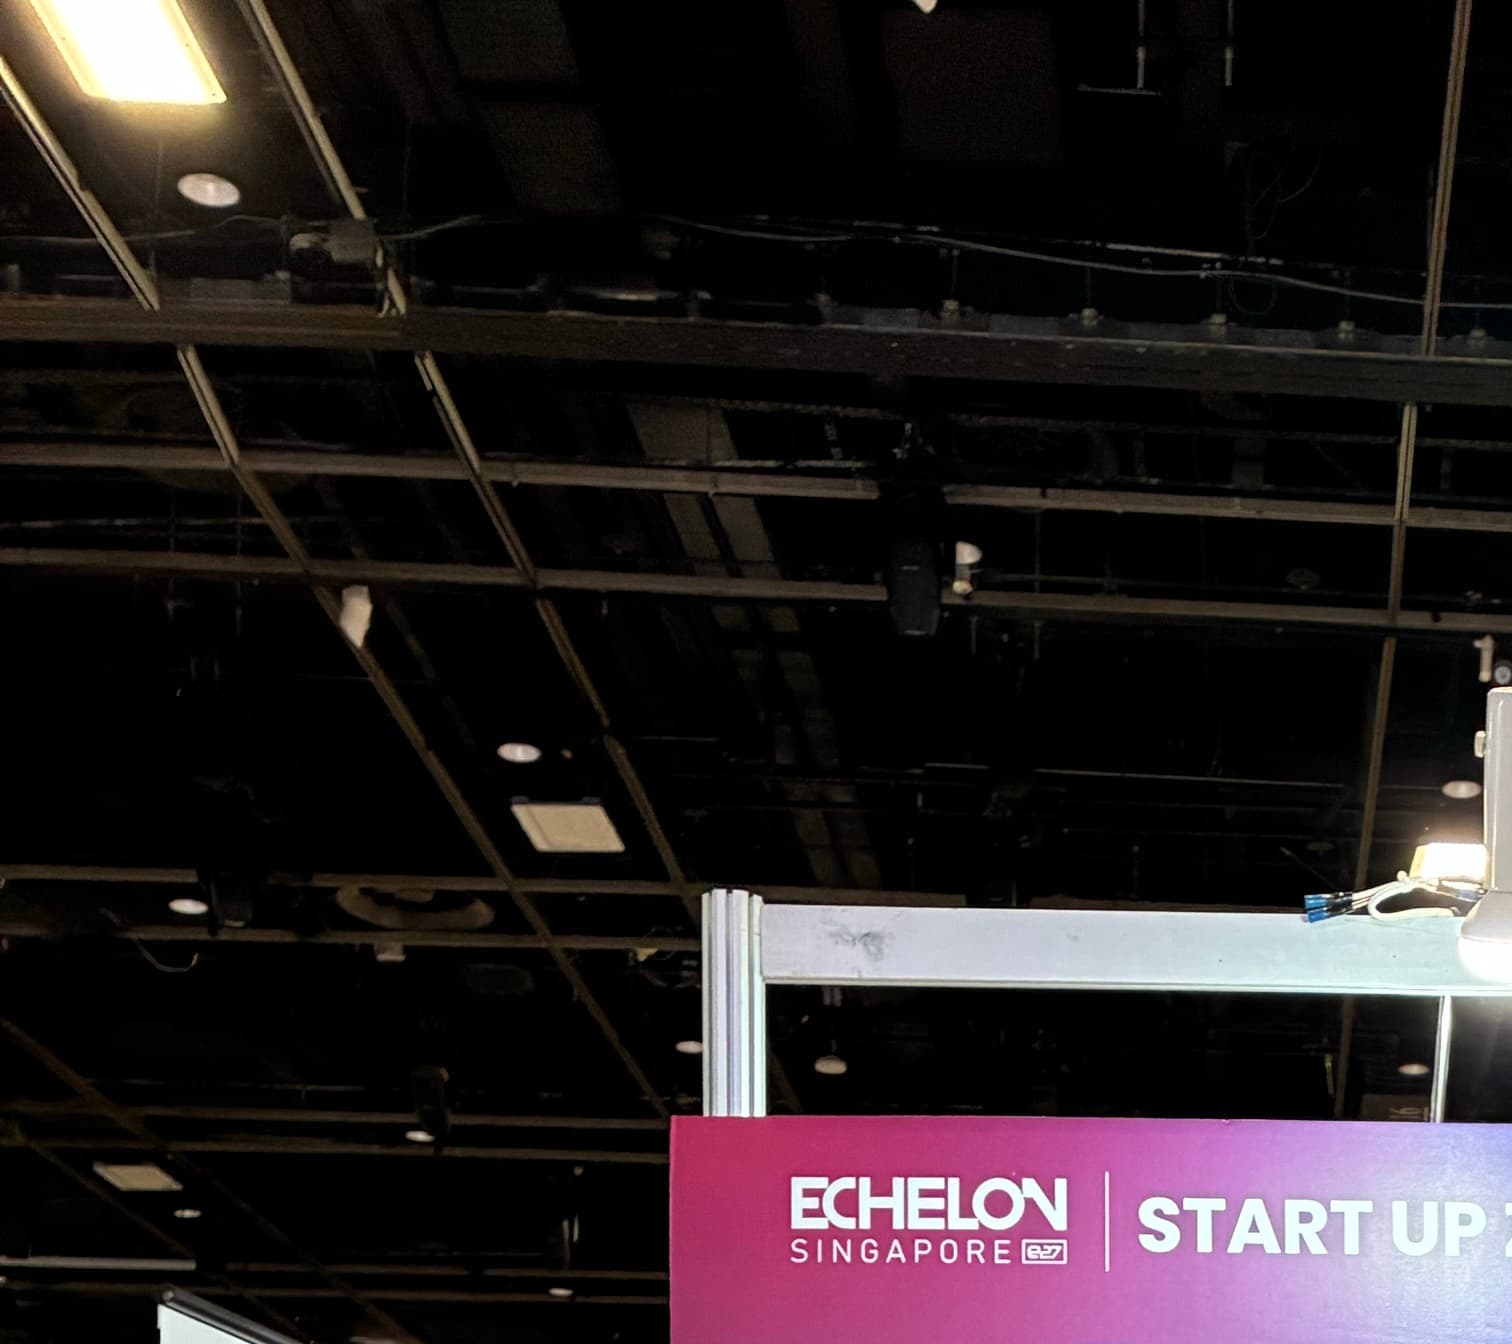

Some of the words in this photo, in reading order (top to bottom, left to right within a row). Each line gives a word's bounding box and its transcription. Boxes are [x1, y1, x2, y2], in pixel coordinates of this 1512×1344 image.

[791, 1177, 1067, 1230] ECHELON
[1138, 1197, 1373, 1256] START
[1392, 1200, 1487, 1259] UP
[790, 1238, 1011, 1265] SINGAPORE
